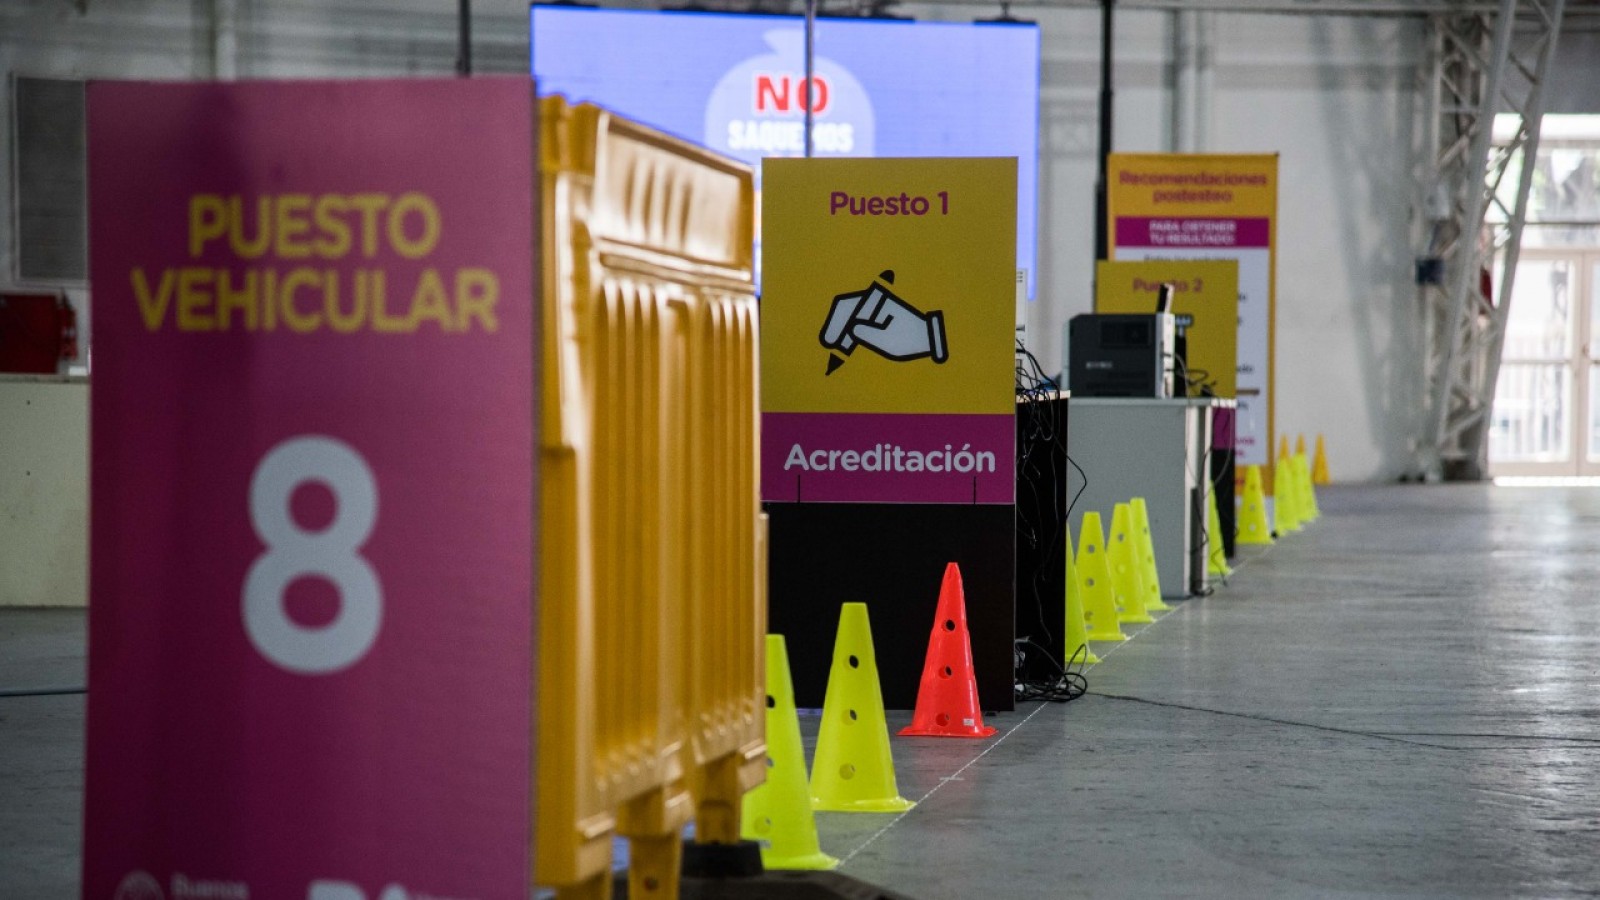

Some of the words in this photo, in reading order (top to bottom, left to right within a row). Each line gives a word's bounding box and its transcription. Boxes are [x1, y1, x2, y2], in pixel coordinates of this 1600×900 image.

[756, 75, 829, 114] NO
[1118, 169, 1268, 186] Recomendaciones
[829, 191, 930, 216] Puesto
[937, 191, 949, 215] 1
[188, 193, 442, 259] PUESTO
[1149, 219, 1180, 232] PARA
[1181, 219, 1237, 232] OBTENER
[1150, 233, 1164, 245] TU
[1193, 277, 1204, 293] 2
[130, 266, 500, 334] VEHICULAR
[784, 443, 996, 473] Acreditación
[240, 433, 385, 676] 8
